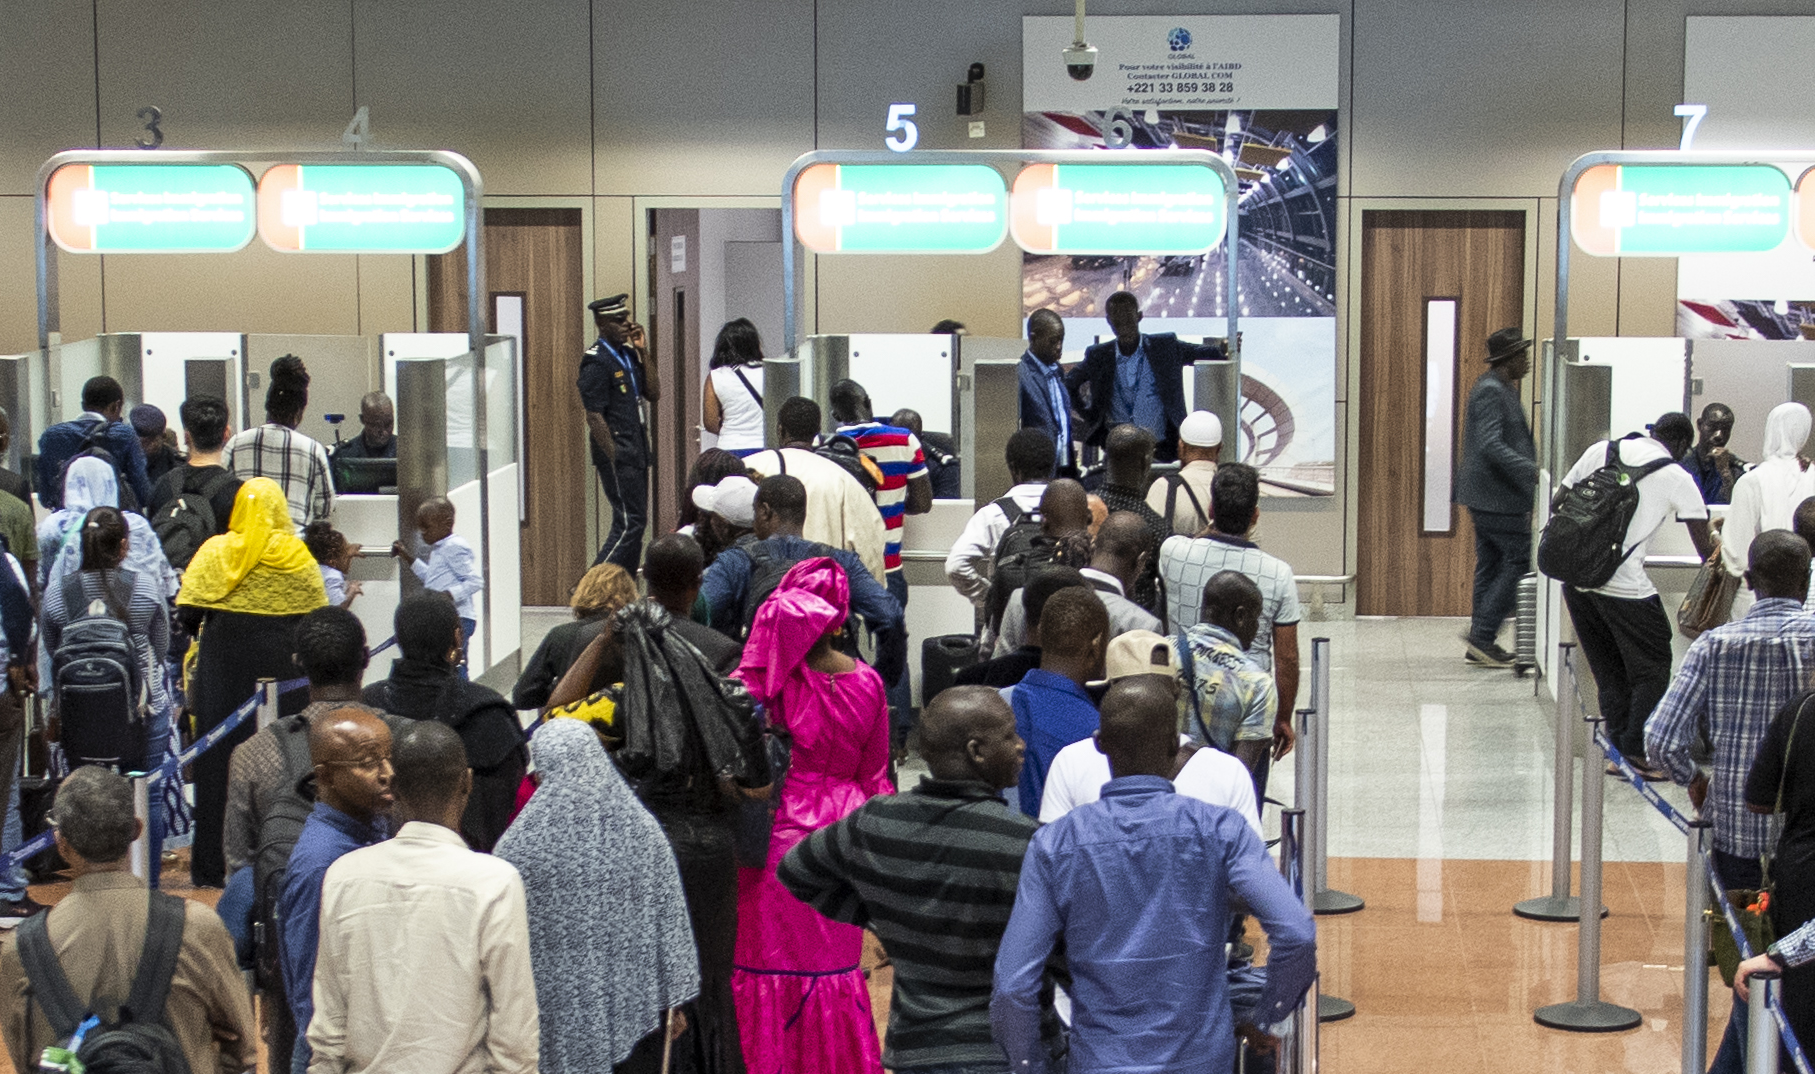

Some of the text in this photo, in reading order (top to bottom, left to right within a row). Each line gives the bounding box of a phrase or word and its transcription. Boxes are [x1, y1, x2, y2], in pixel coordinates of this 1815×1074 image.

[1118, 63, 1140, 71] Pour
[1127, 72, 1233, 80] Contacter GLOBAL COM
[1127, 81, 1234, 93] +221 33 859 38 28
[134, 105, 164, 150] 3
[341, 105, 375, 151] 4
[885, 104, 919, 153] 5
[1101, 105, 1133, 150] 6
[1673, 104, 1707, 151] 7
